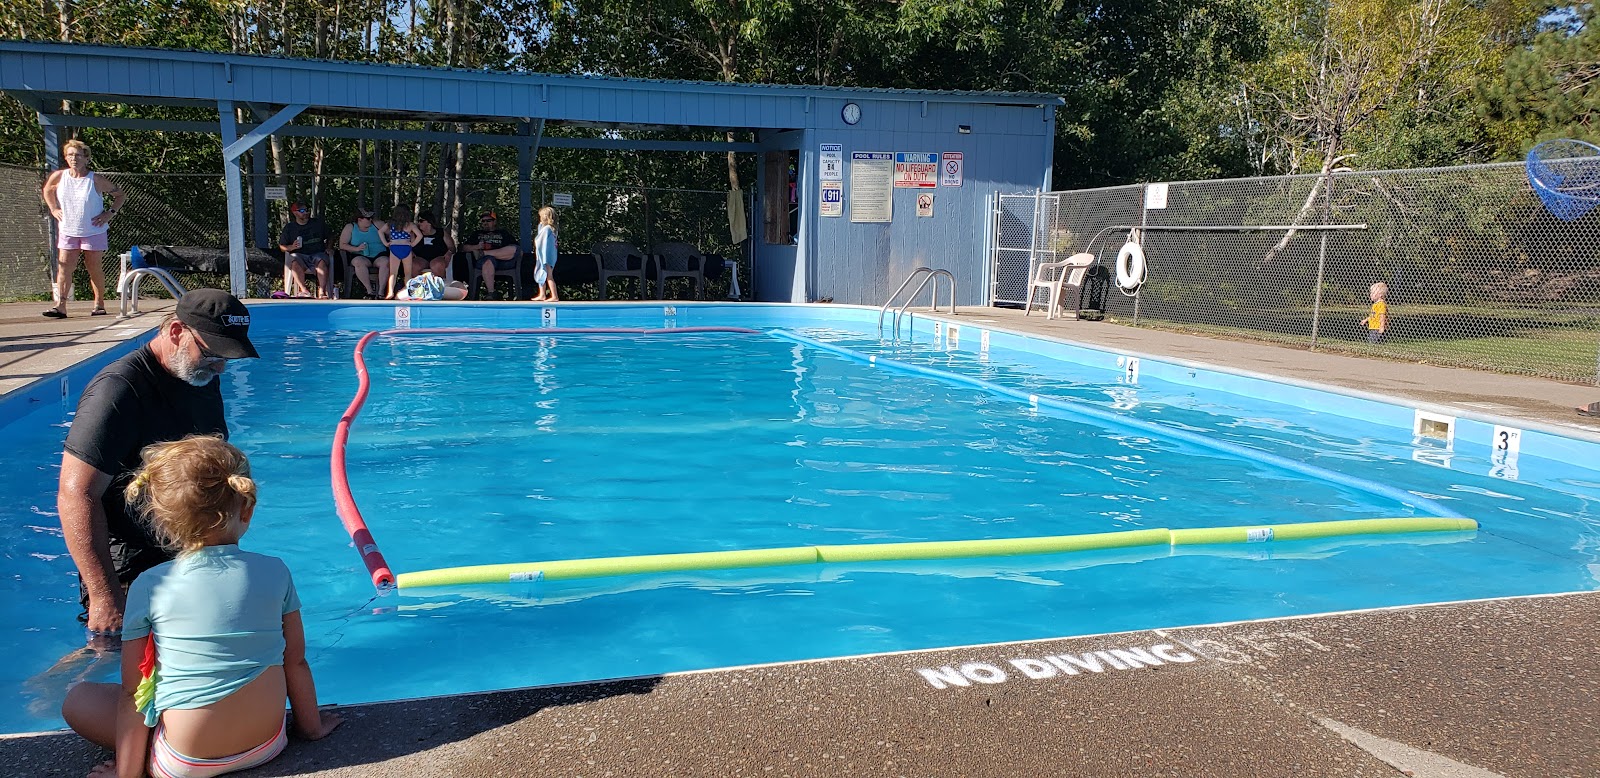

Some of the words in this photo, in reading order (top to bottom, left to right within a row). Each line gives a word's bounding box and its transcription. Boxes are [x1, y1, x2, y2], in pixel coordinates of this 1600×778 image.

[904, 153, 931, 163] WARNING
[896, 163, 905, 172] NO
[906, 163, 936, 173] LIFEGUARD
[903, 172, 912, 181] ON
[913, 172, 928, 181] DUTY
[827, 190, 839, 201] 911
[544, 308, 551, 319] 5
[1497, 430, 1509, 451] 3
[917, 662, 1008, 690] NO
[1008, 644, 1197, 680] DIVING
